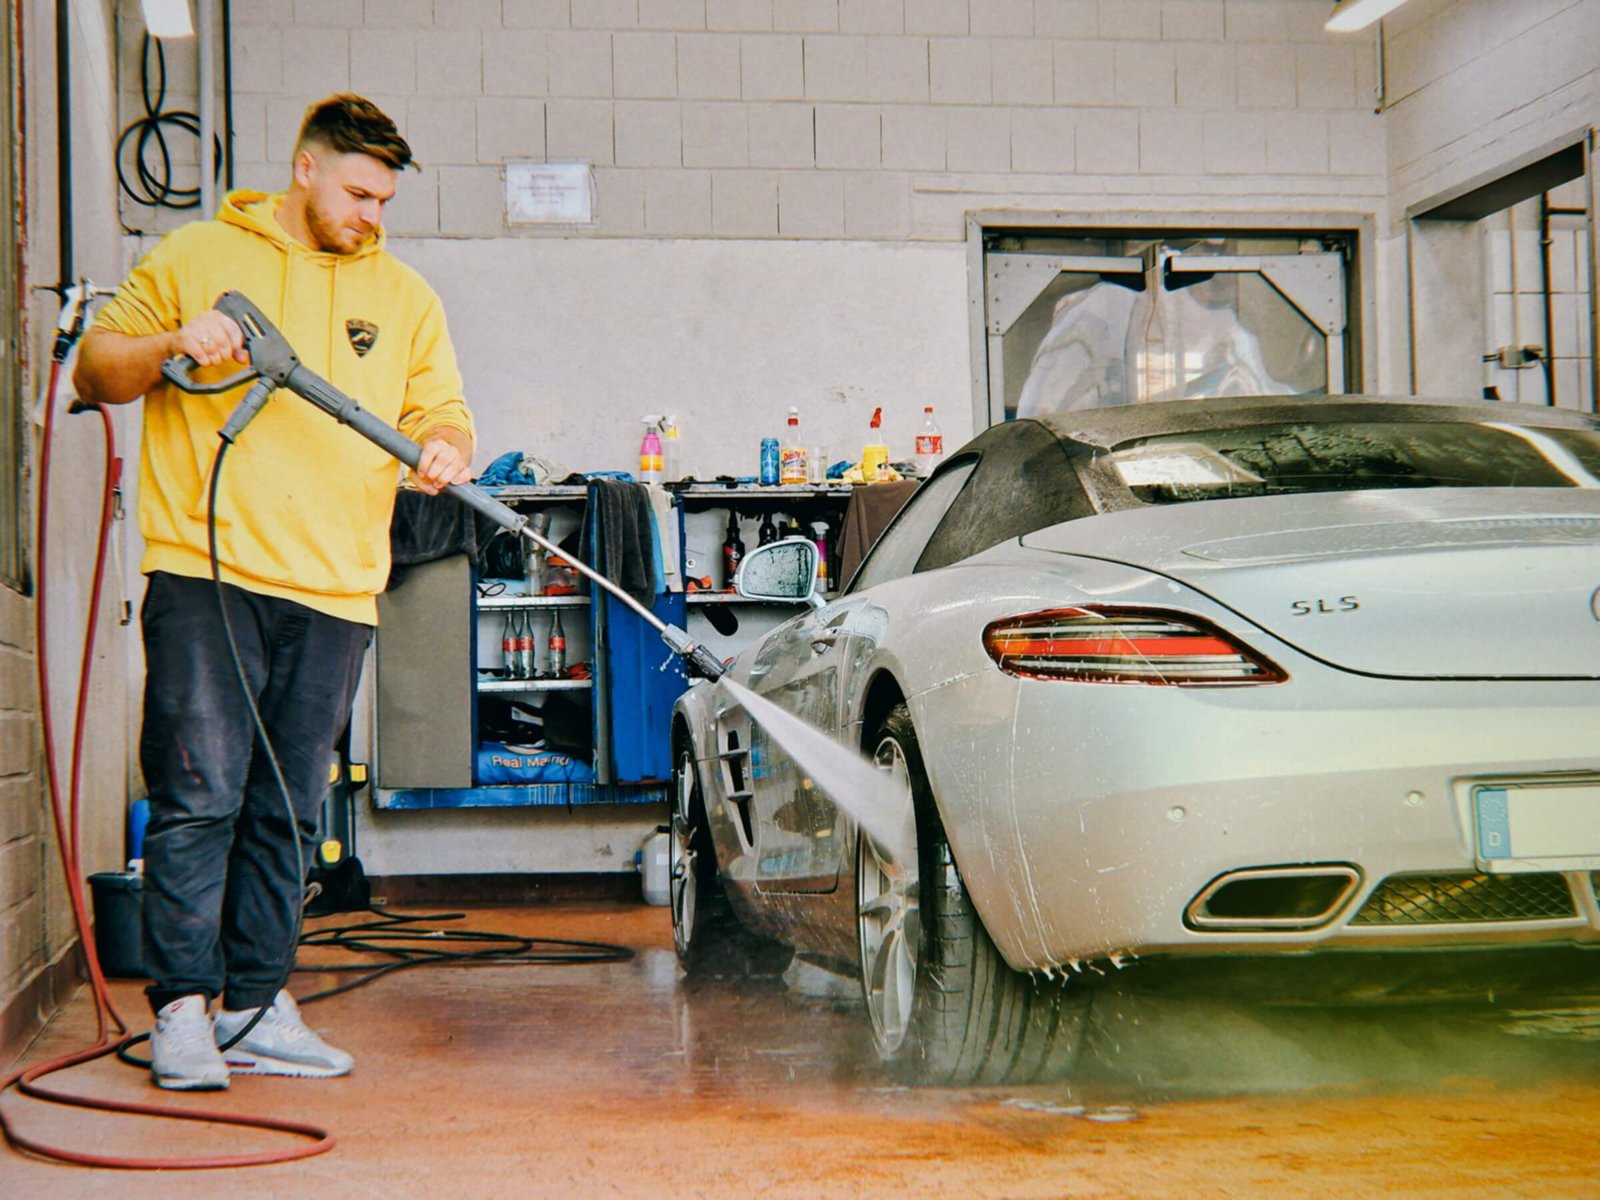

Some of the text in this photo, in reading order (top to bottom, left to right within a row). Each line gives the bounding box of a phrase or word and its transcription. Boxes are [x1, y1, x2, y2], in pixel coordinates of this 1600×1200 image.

[1291, 595, 1360, 616] SLS
[492, 755, 522, 768] Real
[1488, 832, 1501, 847] D
